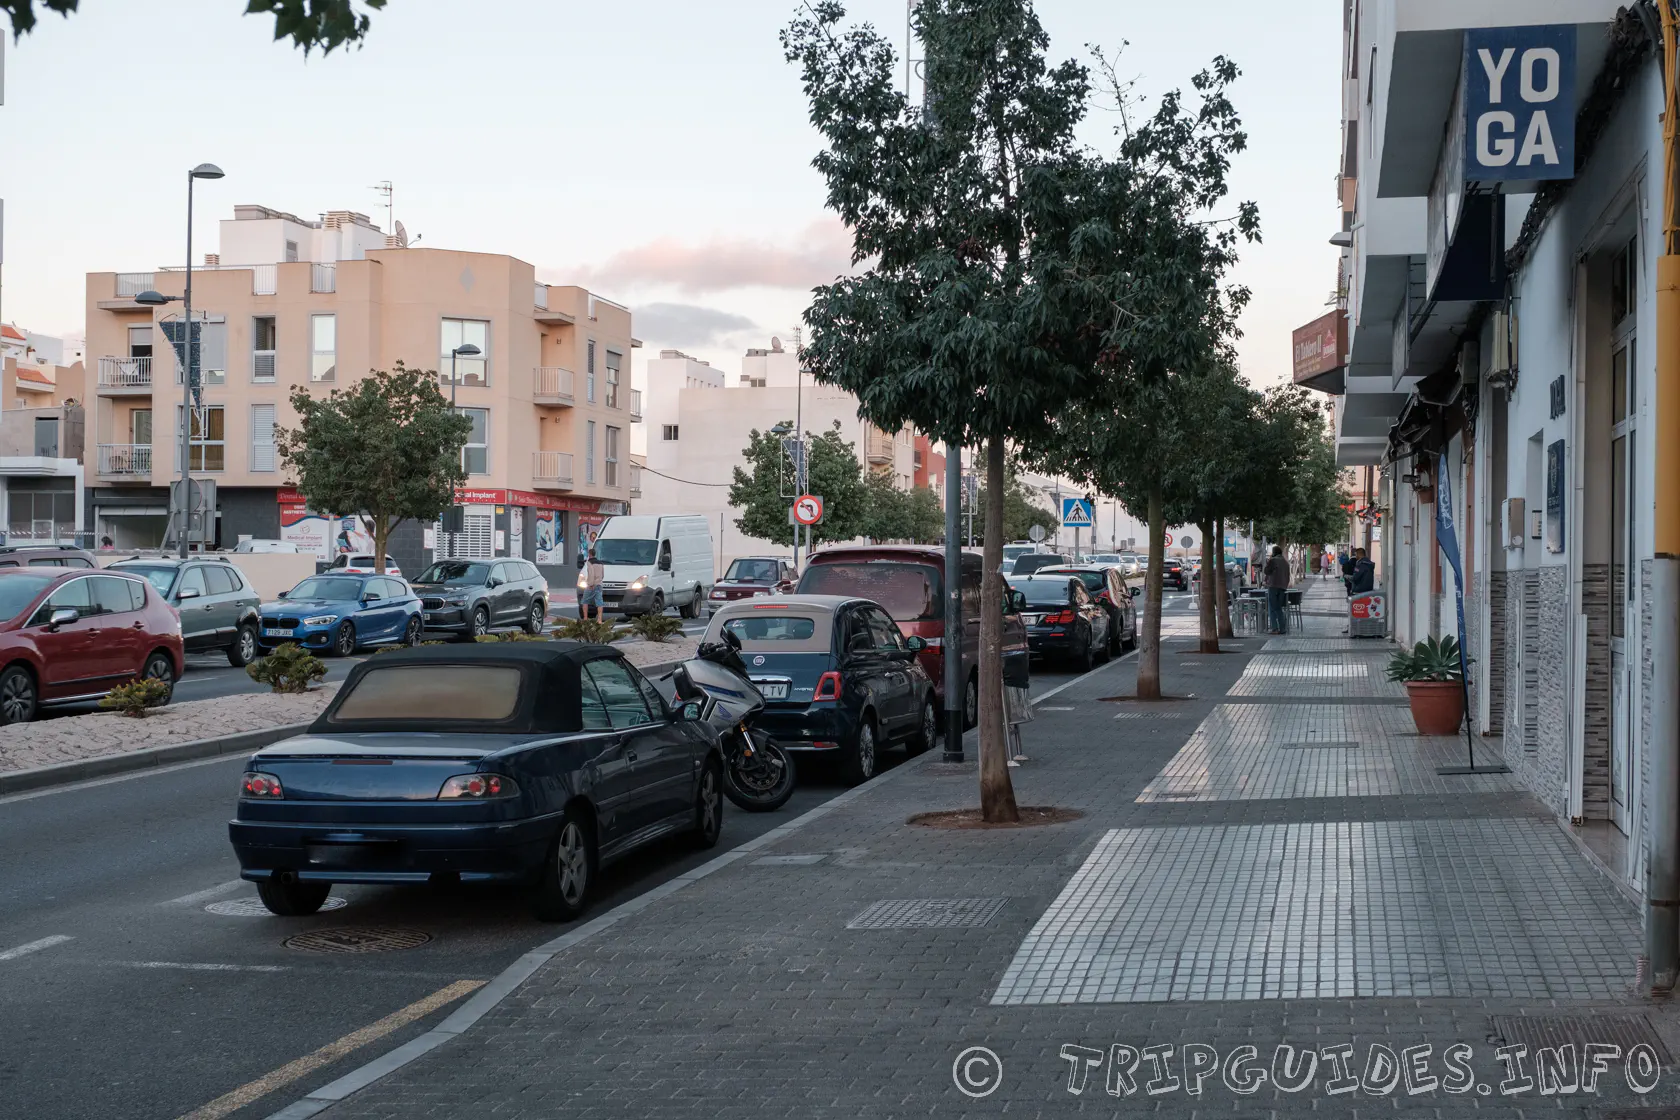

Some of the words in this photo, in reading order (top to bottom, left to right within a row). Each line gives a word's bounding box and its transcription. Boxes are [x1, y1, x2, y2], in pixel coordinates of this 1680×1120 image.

[1477, 47, 1560, 104] YO
[1475, 109, 1560, 167] GA
[762, 685, 785, 697] LTV
